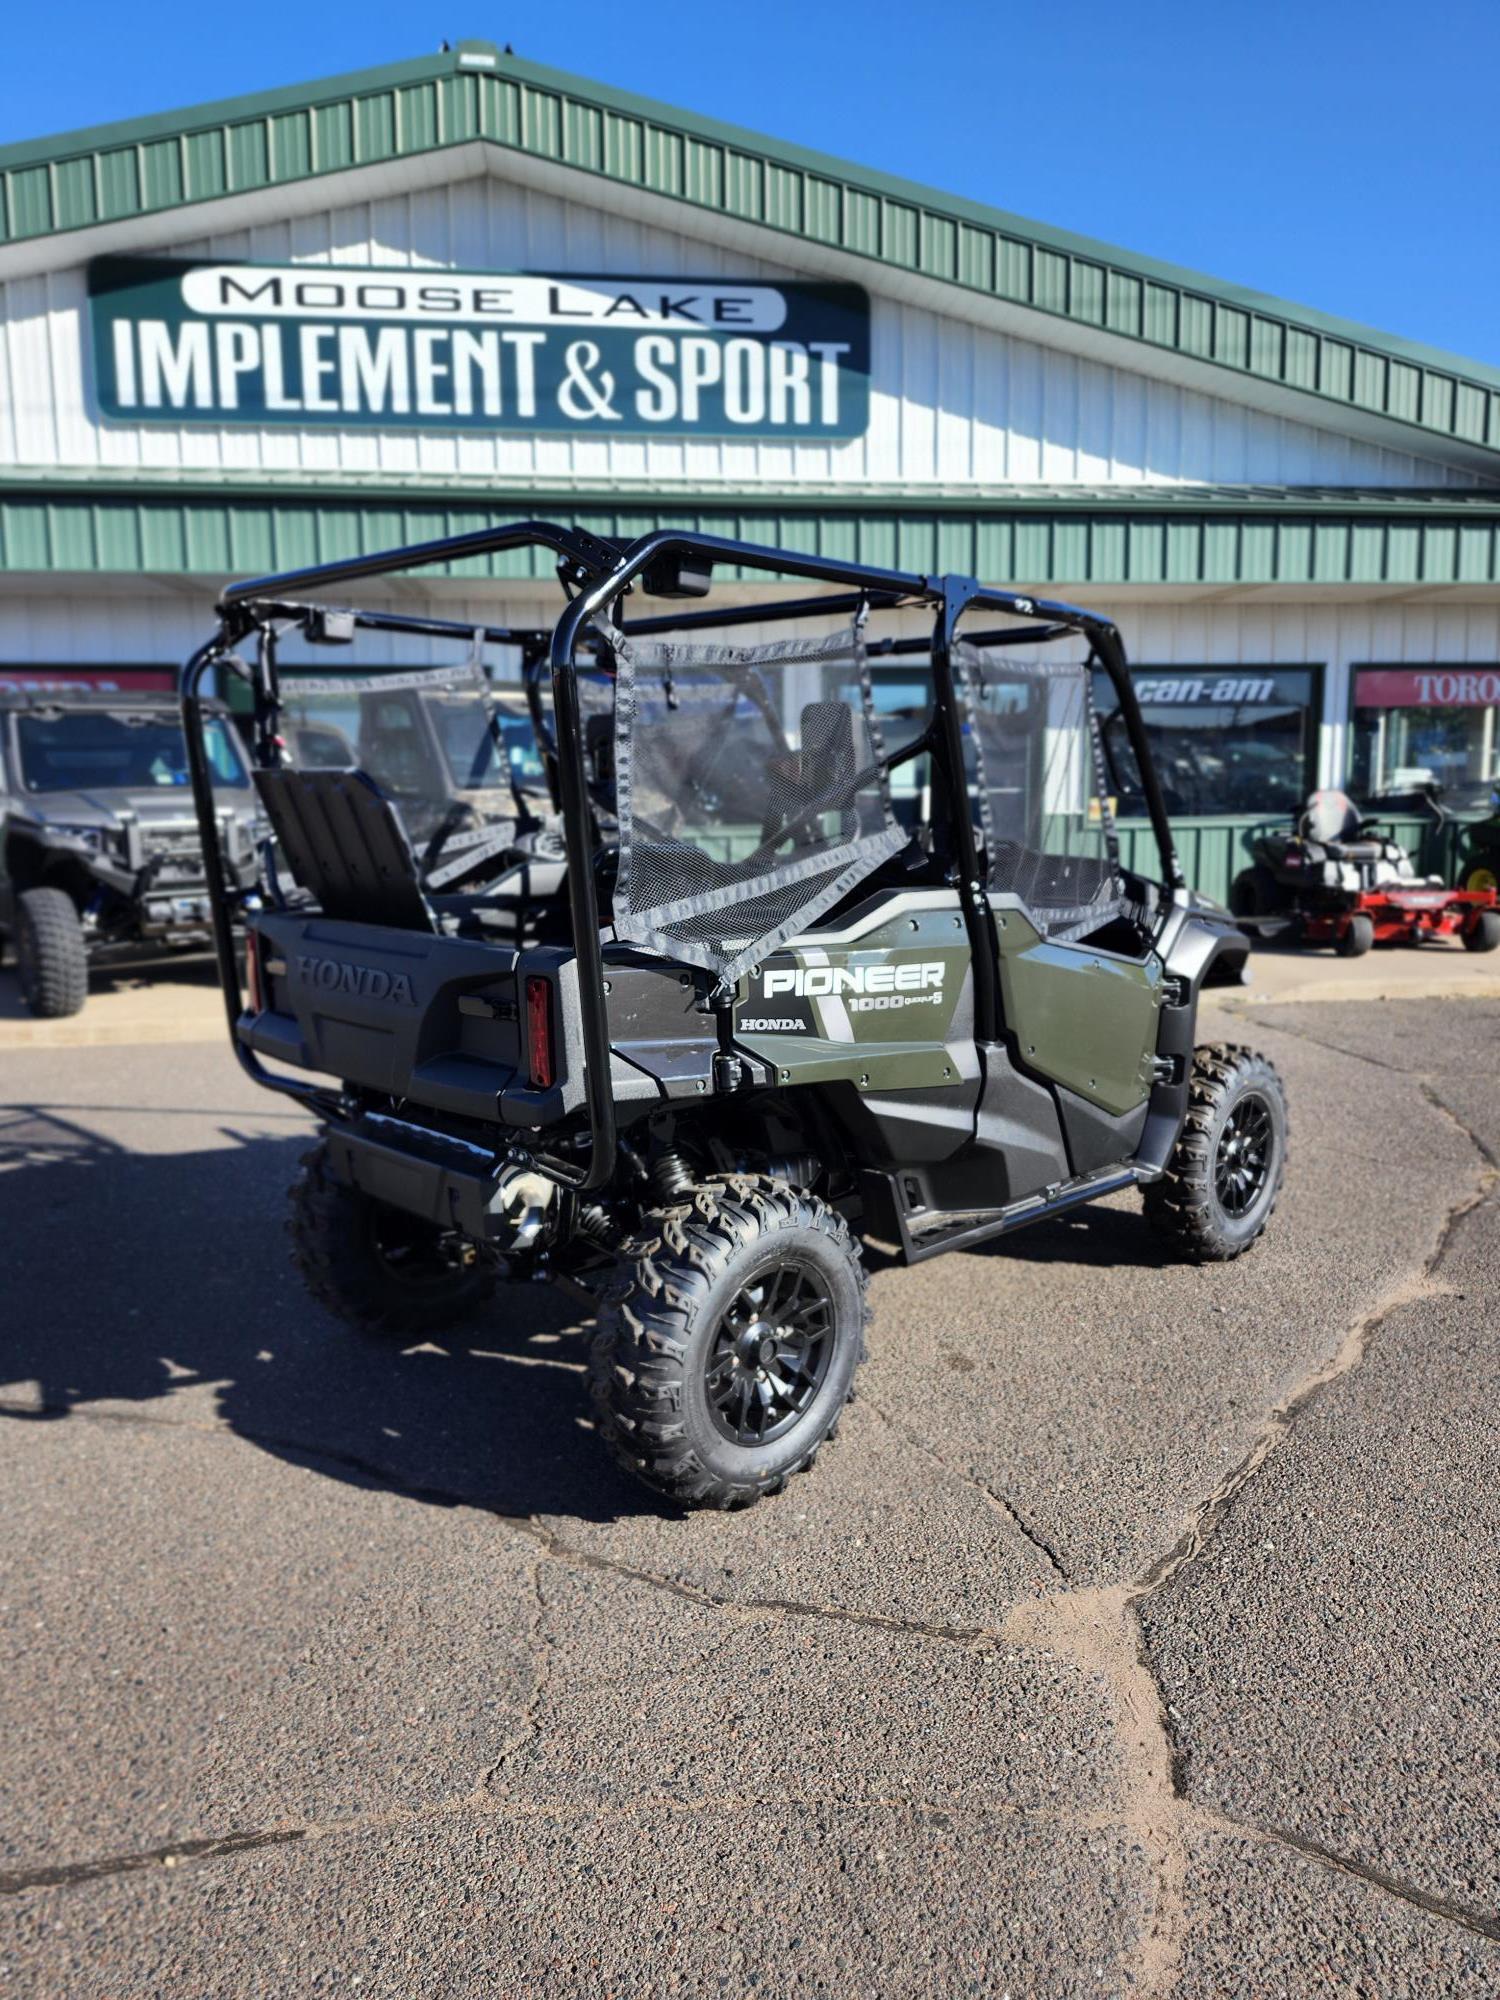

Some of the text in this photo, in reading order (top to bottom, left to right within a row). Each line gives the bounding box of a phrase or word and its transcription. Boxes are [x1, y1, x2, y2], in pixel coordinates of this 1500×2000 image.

[219, 275, 754, 323] MOOSE LAKE
[112, 319, 850, 426] IMPLEMENT & SPORT
[1134, 678, 1275, 703] can-am
[1414, 674, 1500, 705] TORO
[297, 956, 418, 1007] HONDA
[763, 961, 946, 999] PIONEER
[848, 995, 904, 1012] 1000
[740, 1018, 807, 1031] HONDA
